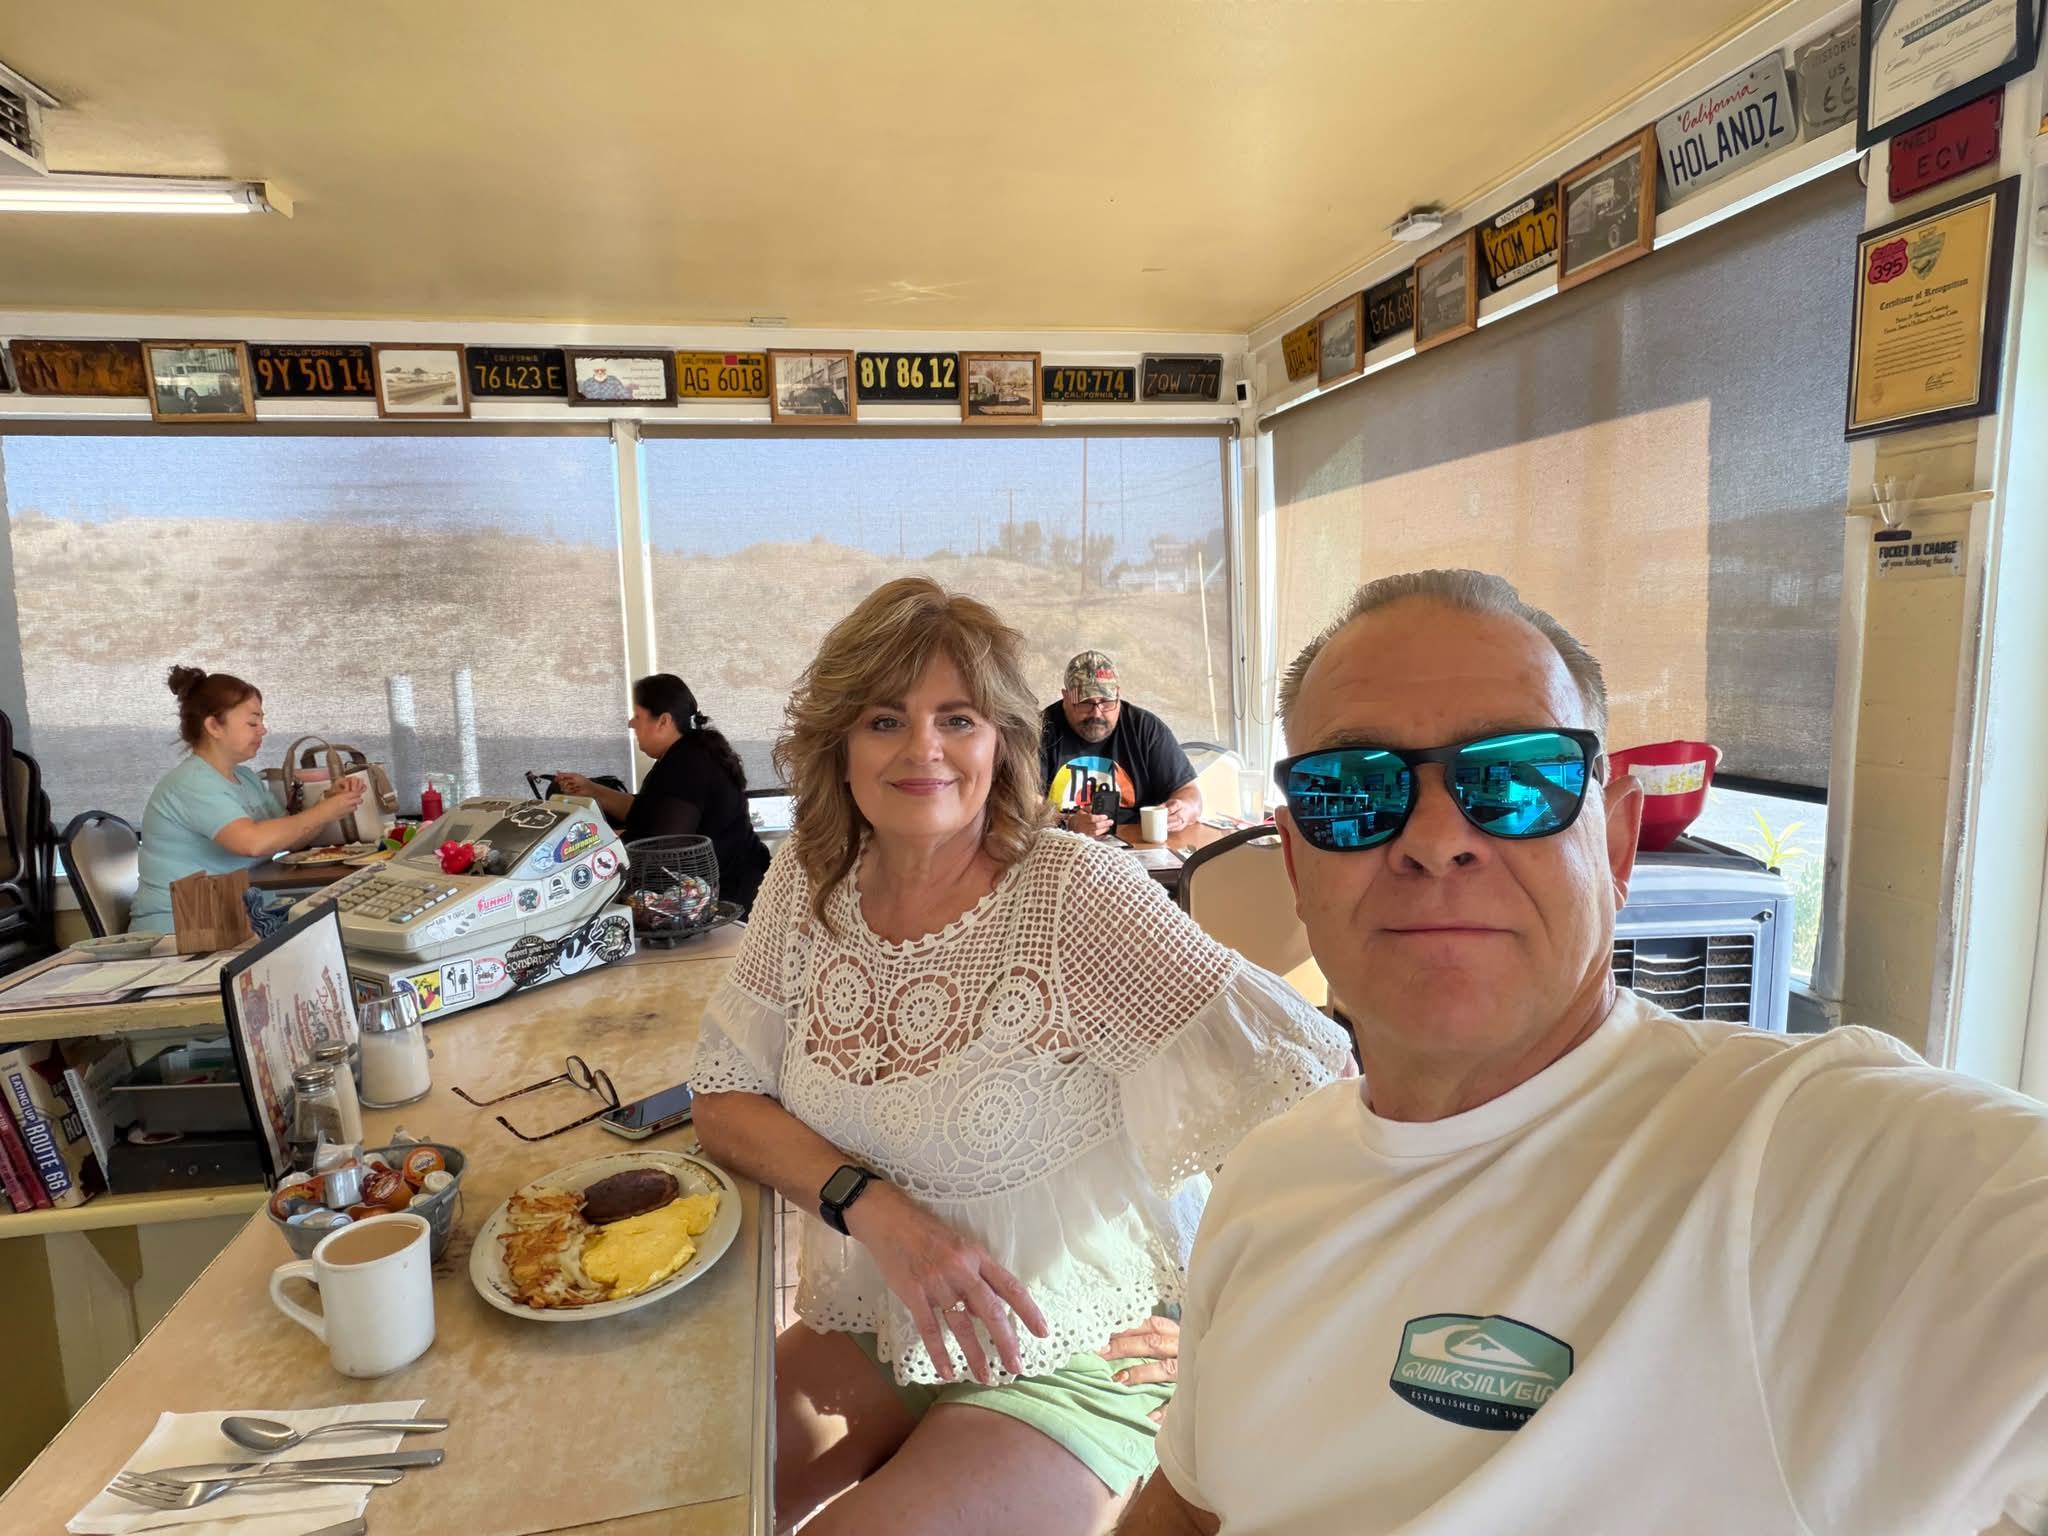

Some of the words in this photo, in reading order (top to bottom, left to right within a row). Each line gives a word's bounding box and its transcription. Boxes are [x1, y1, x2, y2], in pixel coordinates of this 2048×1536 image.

[1828, 63, 1846, 80] US
[1823, 76, 1856, 113] 66
[1681, 83, 1760, 133] California
[1669, 91, 1784, 186] HOLANDZ
[1917, 136, 1969, 177] ECV
[1512, 256, 1545, 276] TRUCKER
[1873, 257, 1903, 281] 395
[257, 358, 291, 391] 9Y
[299, 358, 334, 391] 50
[338, 358, 373, 391] 14
[684, 367, 710, 392] AG
[718, 367, 763, 393] 6018
[860, 357, 889, 388] 8Y
[1187, 373, 1217, 395] 777
[1879, 545, 1909, 558] FUCKER
[1911, 543, 1921, 556] IN
[1923, 540, 1958, 555] CHARGE
[476, 889, 513, 913] Summit
[11, 1075, 29, 1109] EATING
[26, 1123, 61, 1170] ROUTE
[45, 1170, 68, 1191] 66
[1411, 1391, 1480, 1413] ESTABLISHED
[1486, 1407, 1498, 1416] IN
